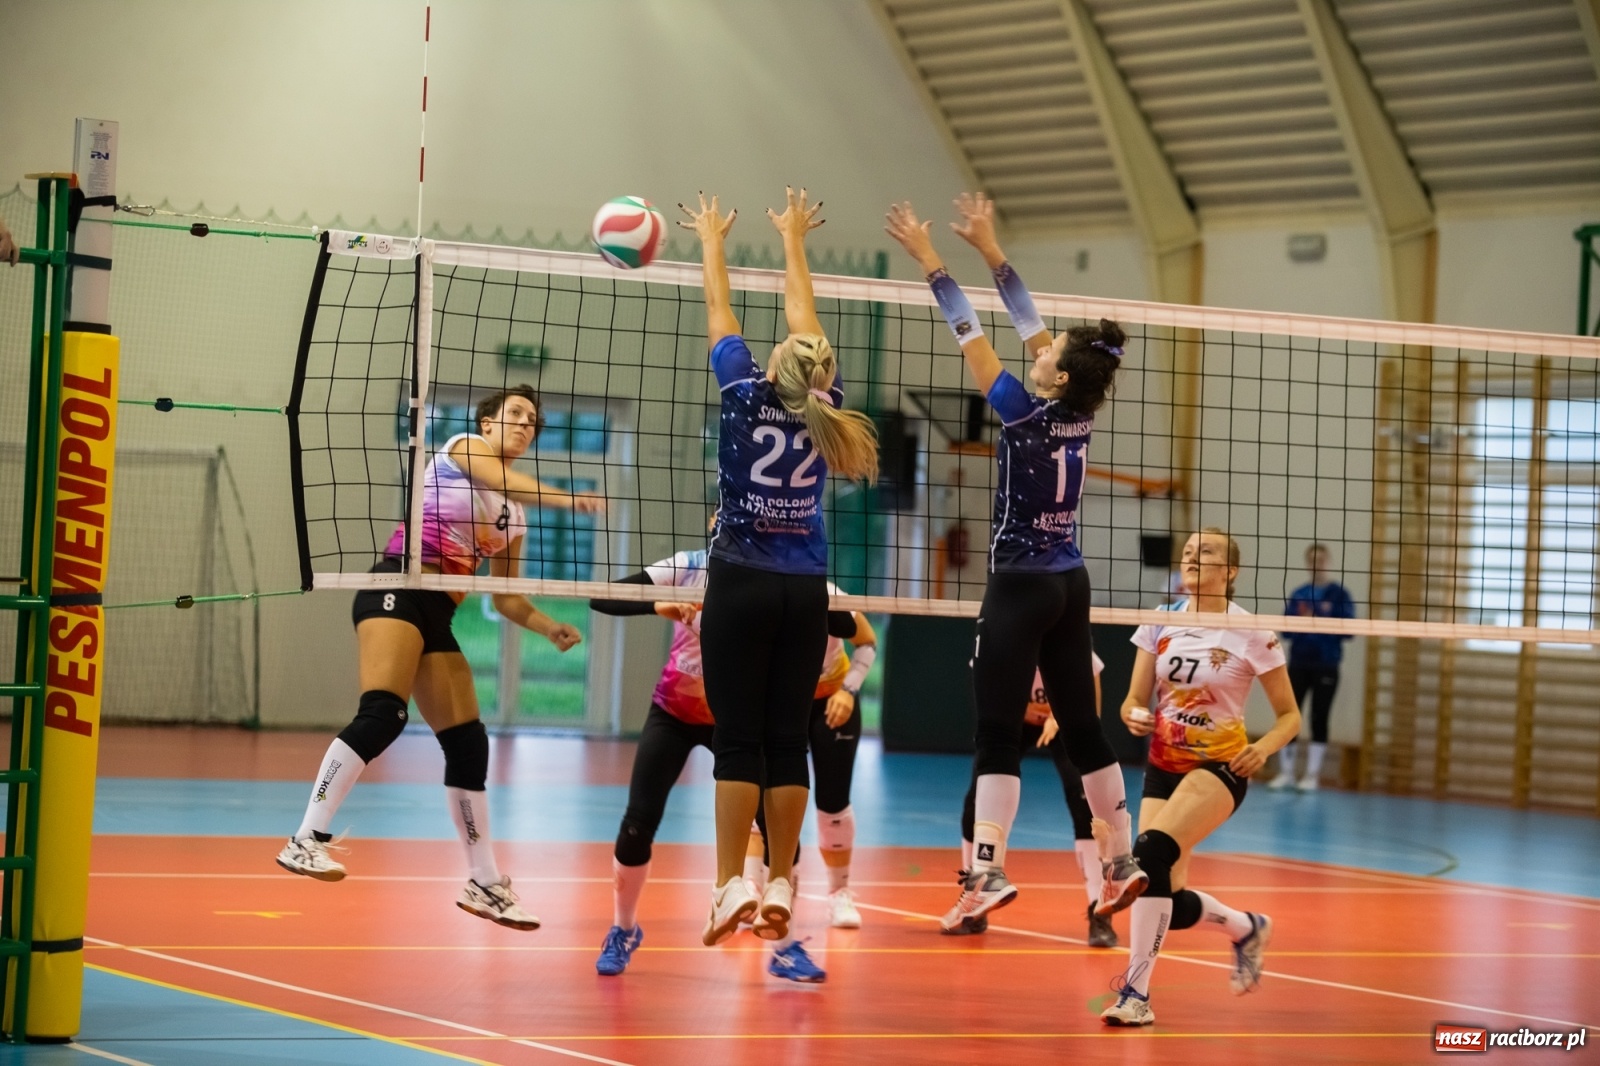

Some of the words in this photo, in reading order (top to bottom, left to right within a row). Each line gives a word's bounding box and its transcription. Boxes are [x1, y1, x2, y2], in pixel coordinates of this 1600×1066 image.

[750, 425, 819, 488] 22
[1051, 442, 1088, 503] 11
[495, 504, 510, 531] 8
[44, 368, 113, 738] PESMENPOL
[382, 592, 396, 611] 8
[1168, 656, 1200, 684] 27
